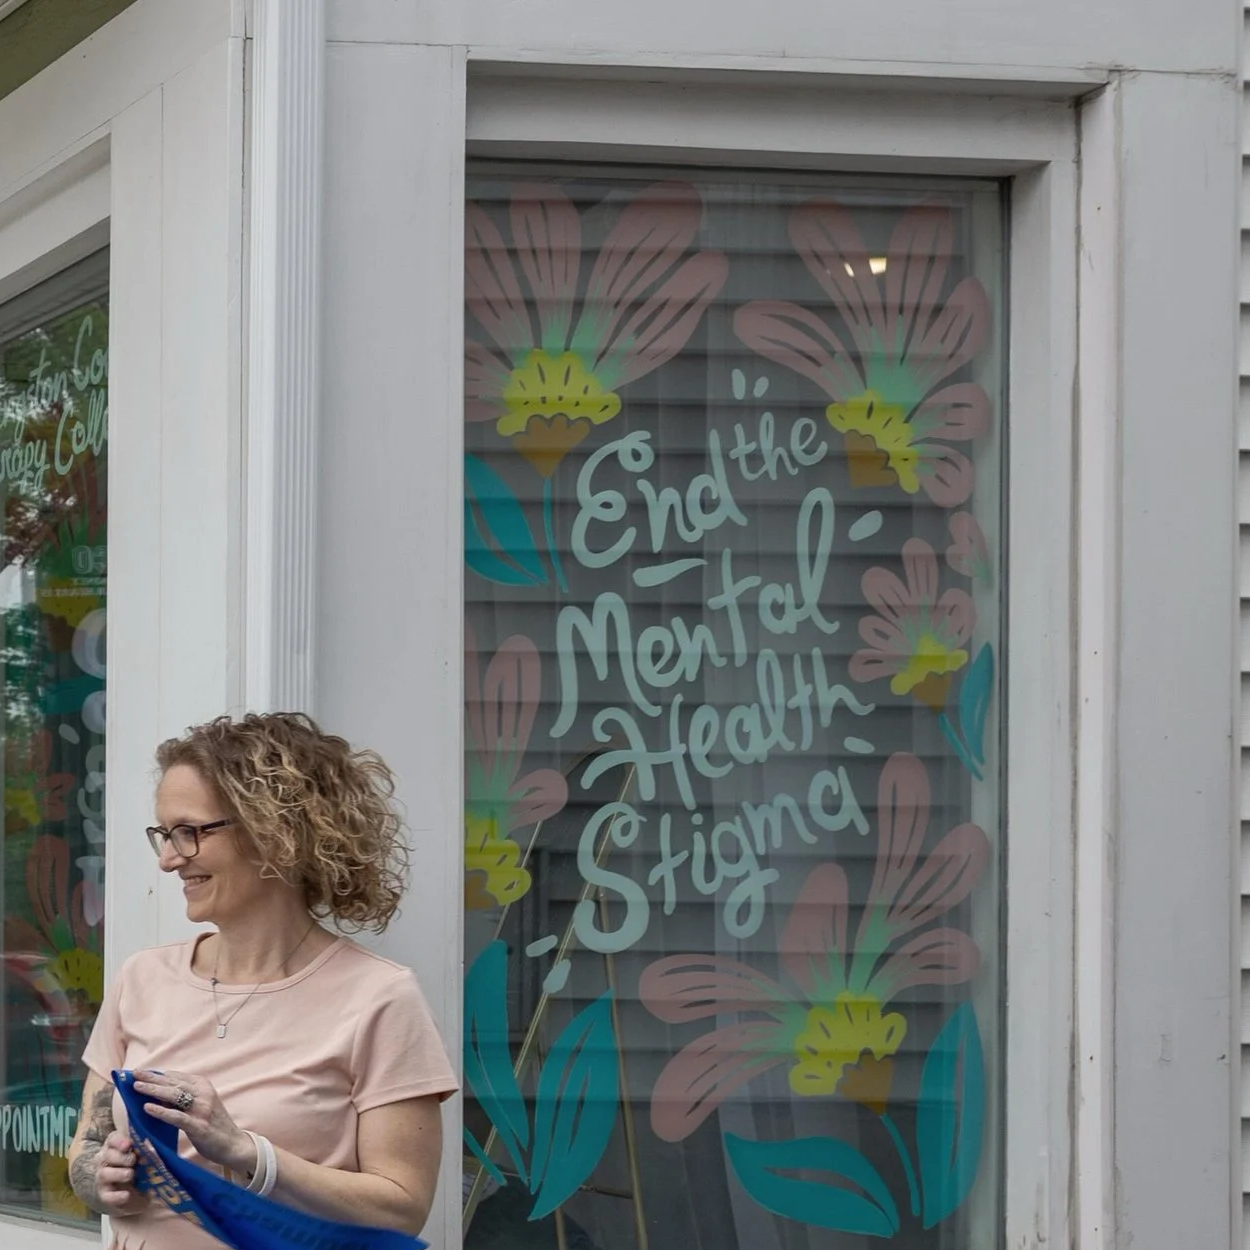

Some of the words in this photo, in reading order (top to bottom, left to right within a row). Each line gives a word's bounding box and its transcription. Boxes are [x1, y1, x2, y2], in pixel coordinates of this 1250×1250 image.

[74, 315, 109, 391] Co
[570, 429, 748, 569] End
[728, 411, 828, 481] the
[549, 487, 840, 738] Mental
[579, 646, 876, 811] Health
[573, 766, 870, 954] Stigma
